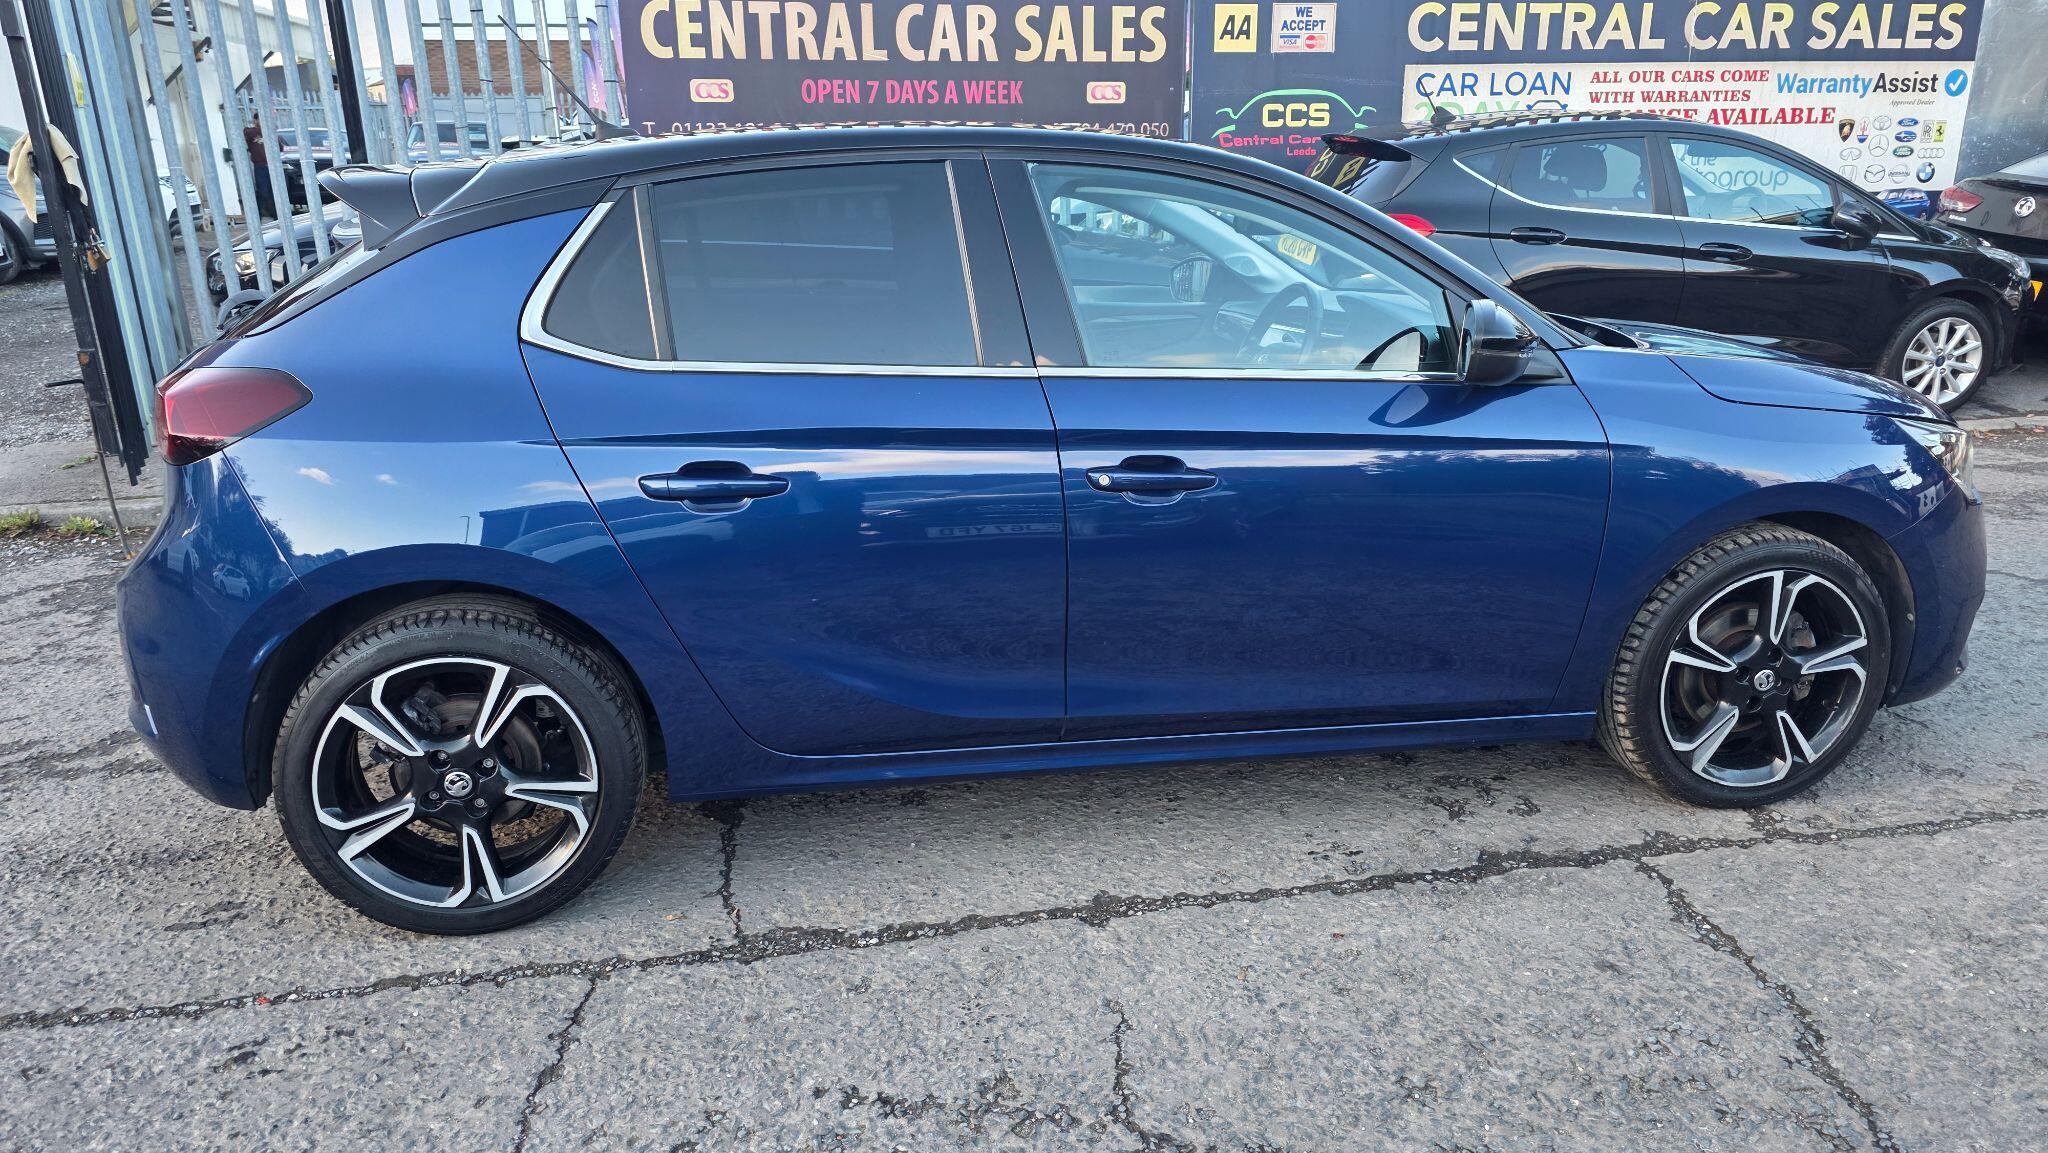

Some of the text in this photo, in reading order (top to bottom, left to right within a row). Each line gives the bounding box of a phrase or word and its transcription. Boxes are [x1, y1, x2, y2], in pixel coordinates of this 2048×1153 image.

[1295, 6, 1313, 18] WE
[640, 0, 1167, 62] CENTRAL CAR SALES
[1219, 14, 1252, 40] AA
[1281, 20, 1326, 31] ACCEPT
[1407, 1, 1967, 52] CENTRAL CAR SALES
[1415, 71, 1572, 97] CAR LOAN
[1590, 70, 1770, 84] ALL OUR CARS COME
[801, 79, 1024, 104] OPEN 7 DAYS A WEEK
[1589, 90, 1751, 104] WITH WARRANTIES
[1262, 103, 1331, 128] CCS
[1706, 107, 1837, 126] AVAILABLE
[1219, 133, 1322, 148] Central Car
[1286, 147, 1317, 156] Leeds
